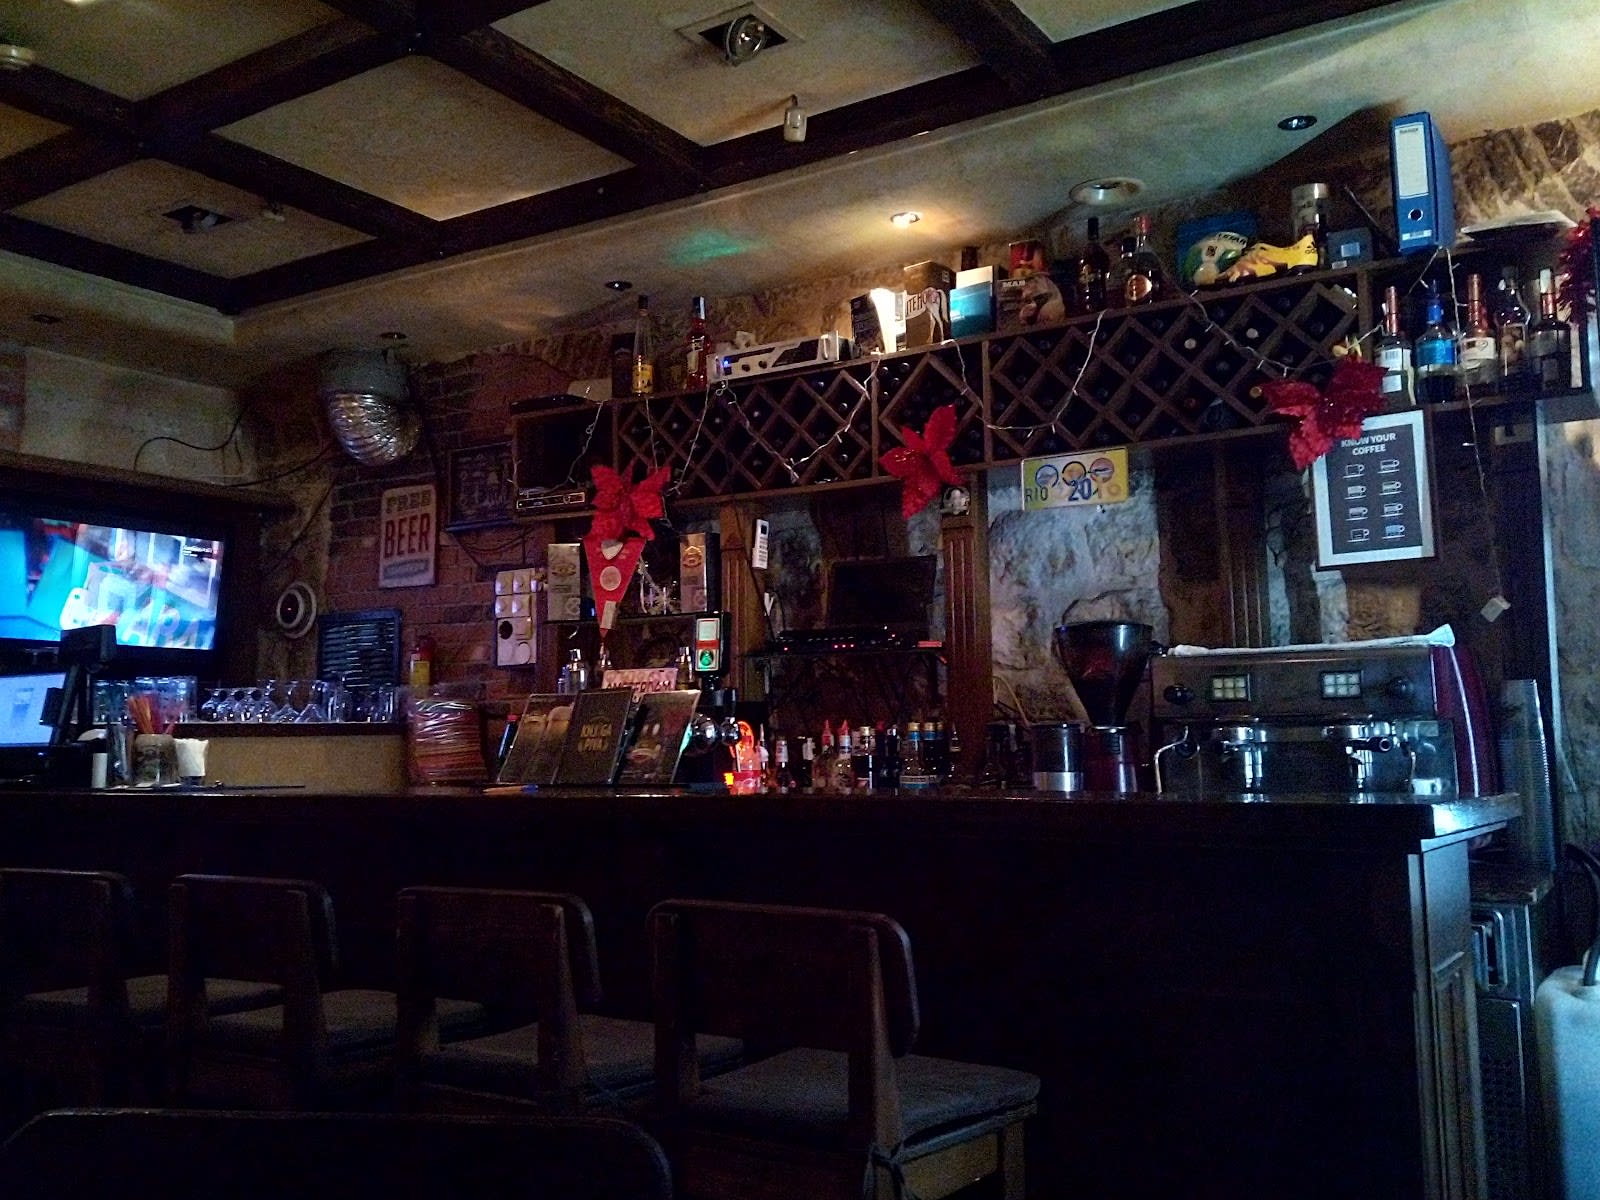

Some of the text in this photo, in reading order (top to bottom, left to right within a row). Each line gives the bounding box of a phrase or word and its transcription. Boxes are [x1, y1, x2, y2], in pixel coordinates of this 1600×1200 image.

[1341, 432, 1397, 448] KNOW YOUR
[1352, 443, 1387, 456] COFFEE
[1024, 486, 1049, 503] RIO
[384, 512, 431, 560] BEER
